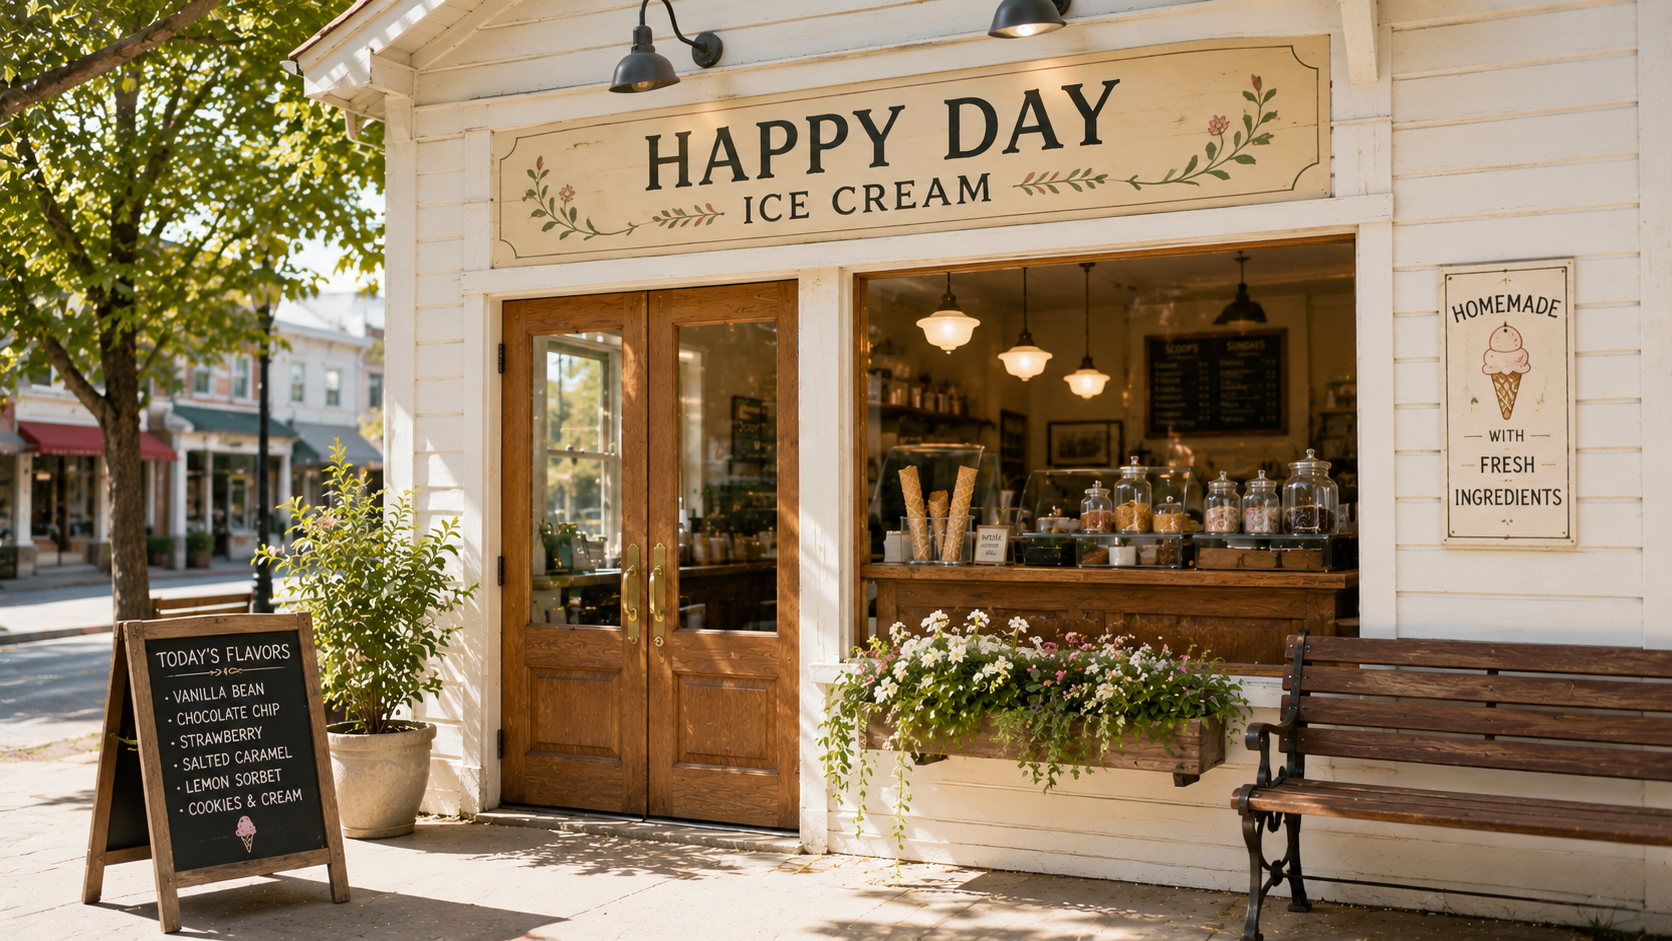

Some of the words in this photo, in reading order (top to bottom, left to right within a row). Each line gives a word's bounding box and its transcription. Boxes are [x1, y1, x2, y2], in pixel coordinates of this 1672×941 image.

[644, 104, 906, 192] HAPPY
[943, 78, 1121, 161] DAY
[743, 190, 811, 225] ICE
[831, 172, 993, 216] CREAM
[1451, 294, 1562, 324] HOMEMADE
[1165, 343, 1199, 355] SCOOPS
[1488, 429, 1525, 442] WITH
[1480, 456, 1536, 474] FRESH
[1455, 488, 1563, 506] INGREDIENTS
[155, 648, 220, 668] TODAY'S
[226, 643, 291, 662] FLAVORS
[172, 686, 227, 704] VANILLA
[231, 682, 265, 698] BEAN
[176, 706, 248, 726] CHOCOLATE
[252, 702, 280, 718] CHIP
[180, 726, 263, 749] STRAWBERRY
[182, 753, 230, 772] SALTED
[234, 746, 293, 764] CARAMEL
[185, 775, 230, 794] LEMON
[235, 768, 283, 787] SORBET
[188, 796, 242, 816] COOKIES
[246, 793, 257, 808] &
[261, 788, 303, 806] CREAM
